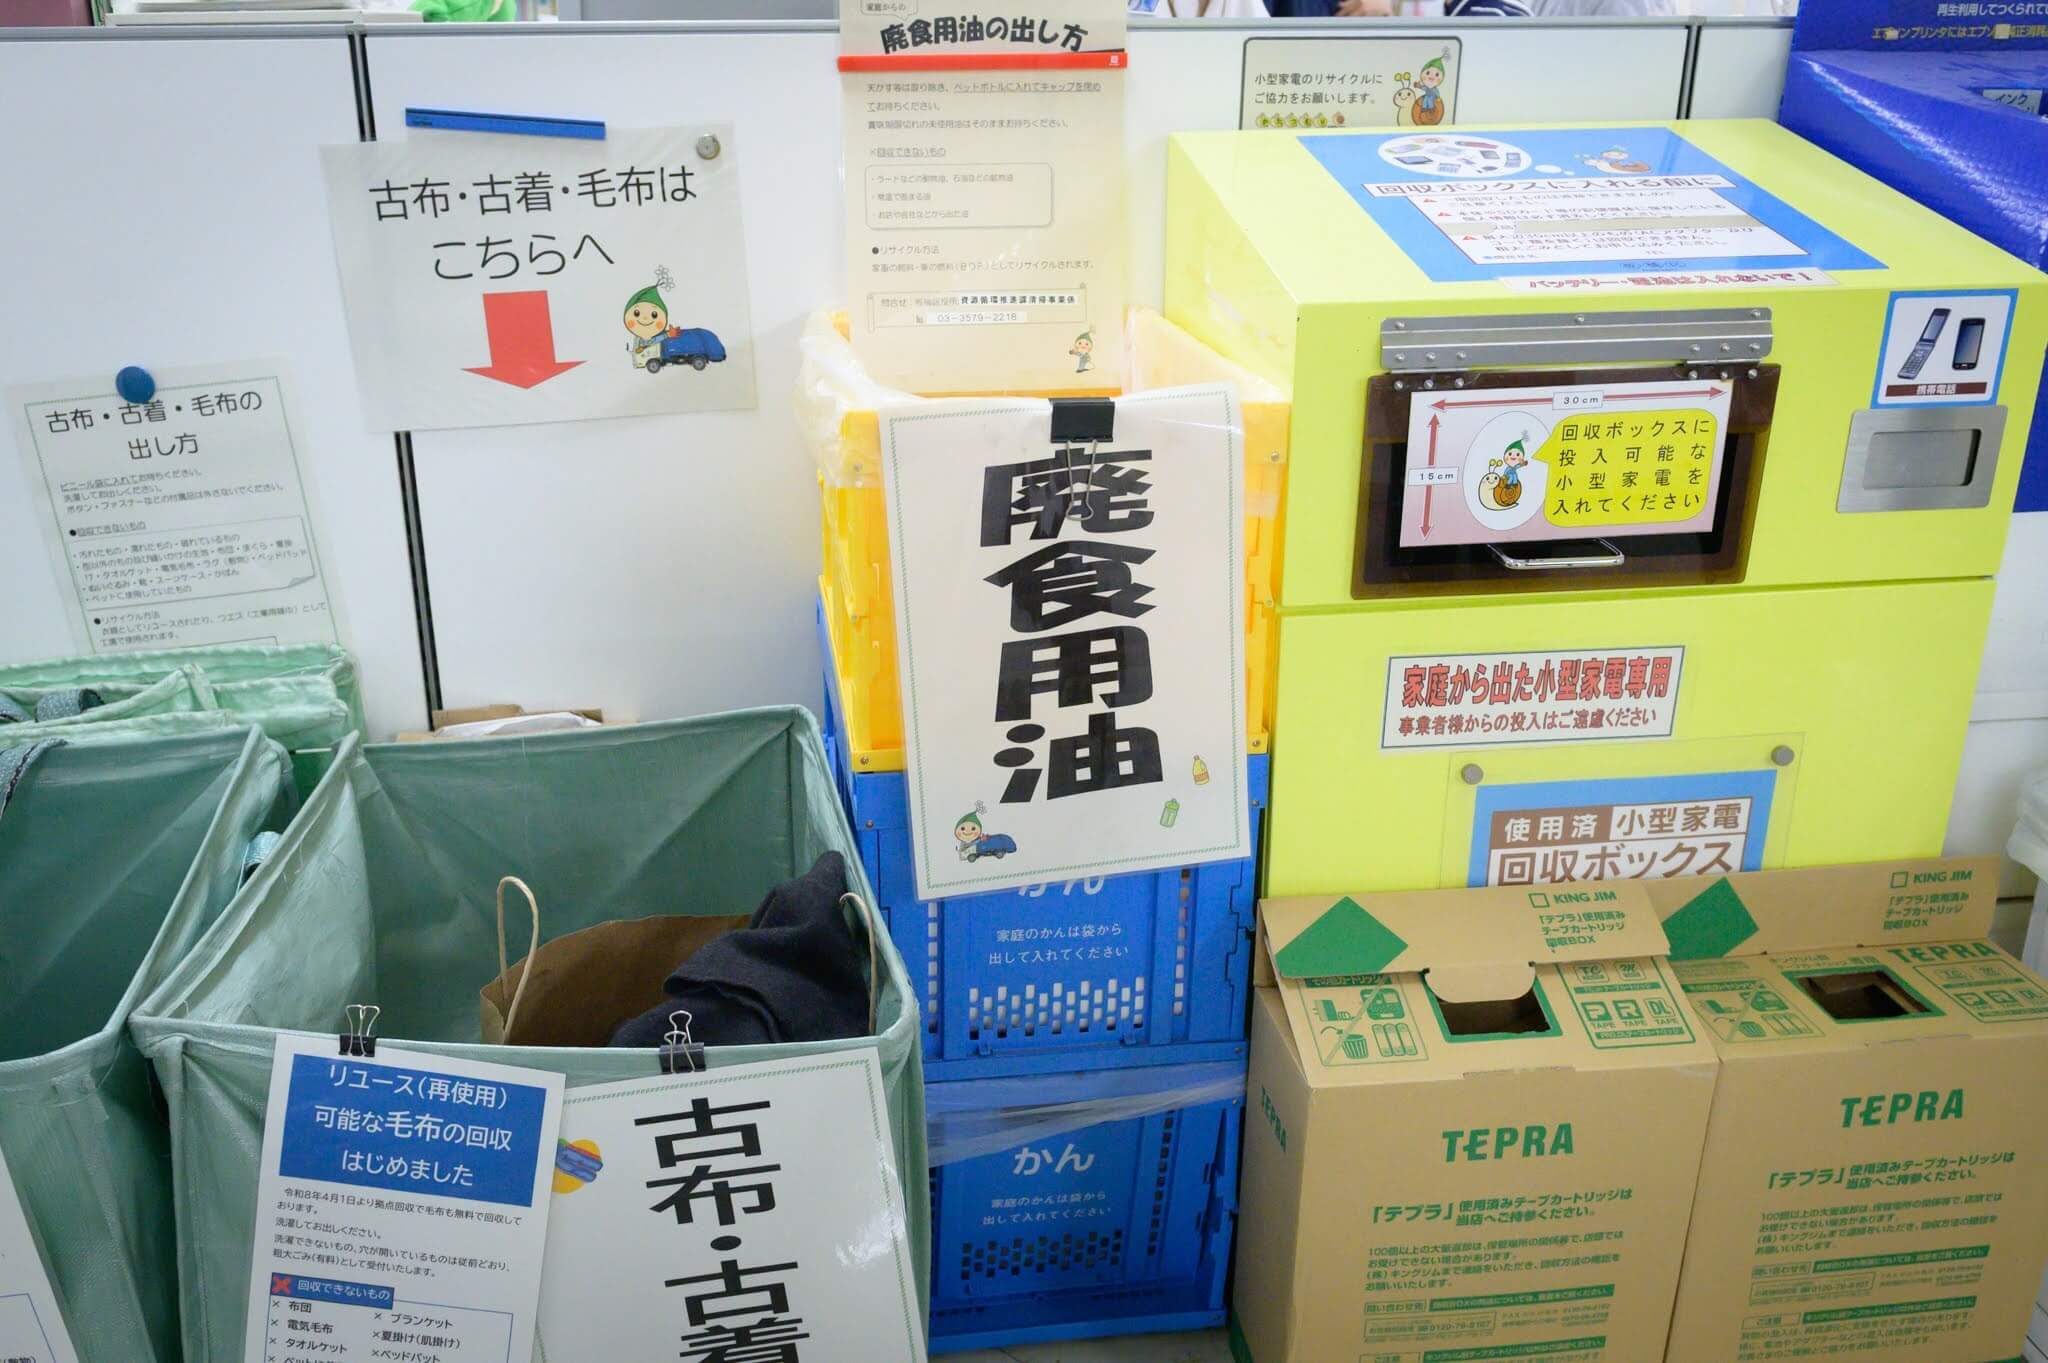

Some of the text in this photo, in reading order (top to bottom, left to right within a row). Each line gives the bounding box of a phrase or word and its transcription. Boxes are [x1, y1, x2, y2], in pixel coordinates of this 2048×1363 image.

[880, 15, 1089, 54] 廃食用油の出し方
[1255, 73, 1383, 86] 小型家電のリサイクルに
[1255, 92, 1376, 105] ご協力をお願いします。
[369, 165, 697, 222] 古布・古着・毛布は
[1376, 176, 1722, 196] 回収ボックスに入れる前に
[433, 234, 615, 280] こちらへ
[1563, 396, 1599, 406] 30cm
[1916, 383, 1957, 396] 携帯電話
[45, 391, 263, 434] 古布・古着・毛布の
[1561, 418, 1711, 442] 回収ボックスに
[128, 432, 199, 461] 出し方
[1559, 443, 1708, 468] 投入可能な
[1418, 471, 1455, 482] 15cm
[1555, 467, 1704, 491] 小型家電を
[1552, 493, 1701, 516] 入れてください
[980, 447, 1164, 804] 廃食用油
[1401, 656, 1673, 709] 家庭から出た小型家電専用
[1398, 707, 1657, 737] 事業者様からの投入はご遠慮ください
[1504, 803, 1743, 843] 使用済 小型家電
[1501, 840, 1733, 886] 回収ボックス
[1913, 869, 1973, 884] KING JIM
[1553, 890, 1617, 904] KING JIM
[996, 923, 1122, 943] 家庭のかんは袋から
[1542, 922, 1625, 935] テープカートリッジ
[989, 945, 1129, 965] 出して入れてください
[1888, 939, 2000, 964] TEPRA
[328, 1064, 508, 1110] リユース(再使用)
[1841, 1089, 1964, 1128] TEPRA
[314, 1105, 513, 1151] 可能な毛布の回収
[1442, 1123, 1575, 1162] TEPRA
[342, 1149, 474, 1186] はじめました
[1013, 1143, 1095, 1176] かん
[1768, 1152, 2016, 1190] 「テプラ」 使用済みテープカートリッジは
[277, 1201, 318, 1215] おります。
[283, 1187, 522, 1227] 令和8年4月1日より拠点回収で毛布も無料で回収して
[991, 1192, 1107, 1209] 家庭のかんは袋から
[1372, 1188, 1633, 1224] 「テプラ」 使用済みテープカートリッジは
[983, 1207, 1112, 1225] 出して入れてください
[1456, 1206, 1595, 1227] 当店へご持参ください。
[275, 1217, 382, 1240] 洗濯してお出しください。
[634, 1097, 811, 1363] 古布・古着
[273, 1248, 436, 1278] 粗大ごみ(有料)として受付いたします。
[274, 1234, 511, 1272] 洗濯できないもの、穴が開いているものは従前どおり、
[297, 1280, 391, 1301] 回収できないもの
[289, 1301, 313, 1314] 布団
[287, 1318, 334, 1335] 電気毛布
[391, 1312, 453, 1329] ブランケット
[285, 1338, 348, 1354] タオルケット
[382, 1330, 461, 1349] 夏掛け(肌掛け)
